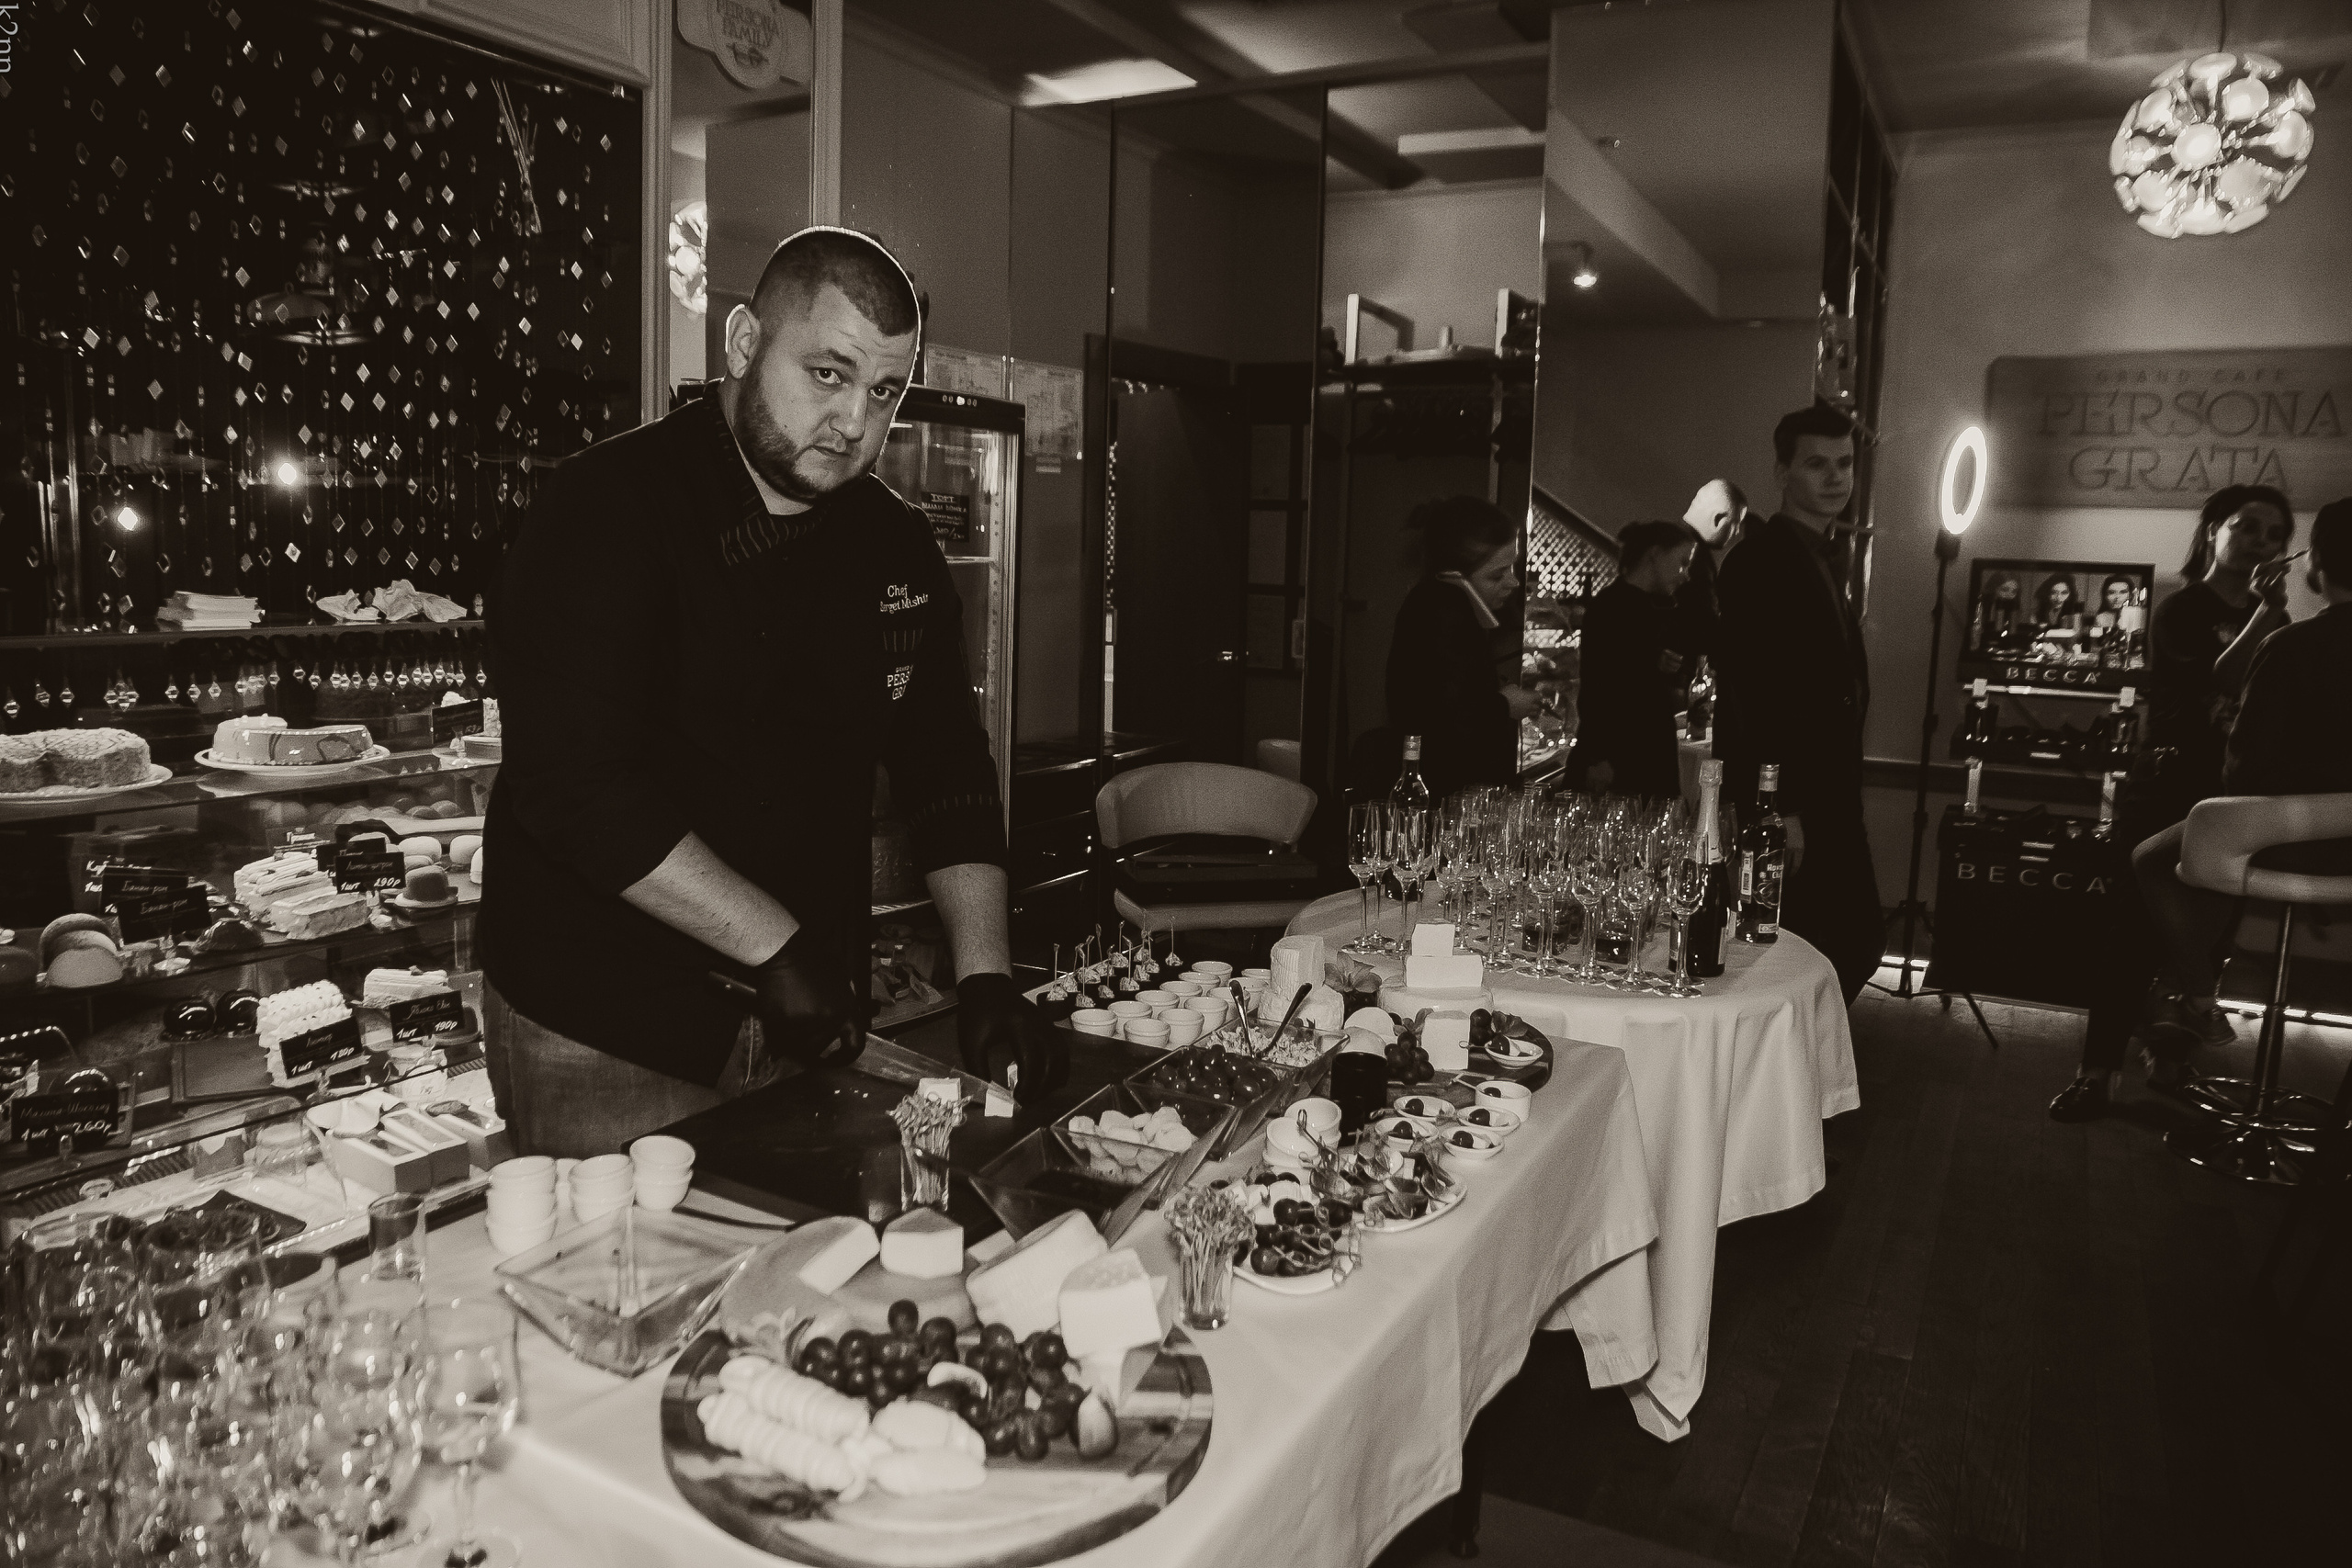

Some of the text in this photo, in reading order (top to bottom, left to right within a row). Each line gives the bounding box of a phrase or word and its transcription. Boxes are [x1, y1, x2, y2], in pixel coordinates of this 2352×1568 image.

[2036, 389, 2347, 439] PERSONA
[2068, 444, 2291, 493] GRATA
[887, 584, 908, 599] Chef
[887, 671, 912, 687] PERS
[2006, 667, 2100, 683] BECCA
[1957, 863, 2107, 895] BECCA
